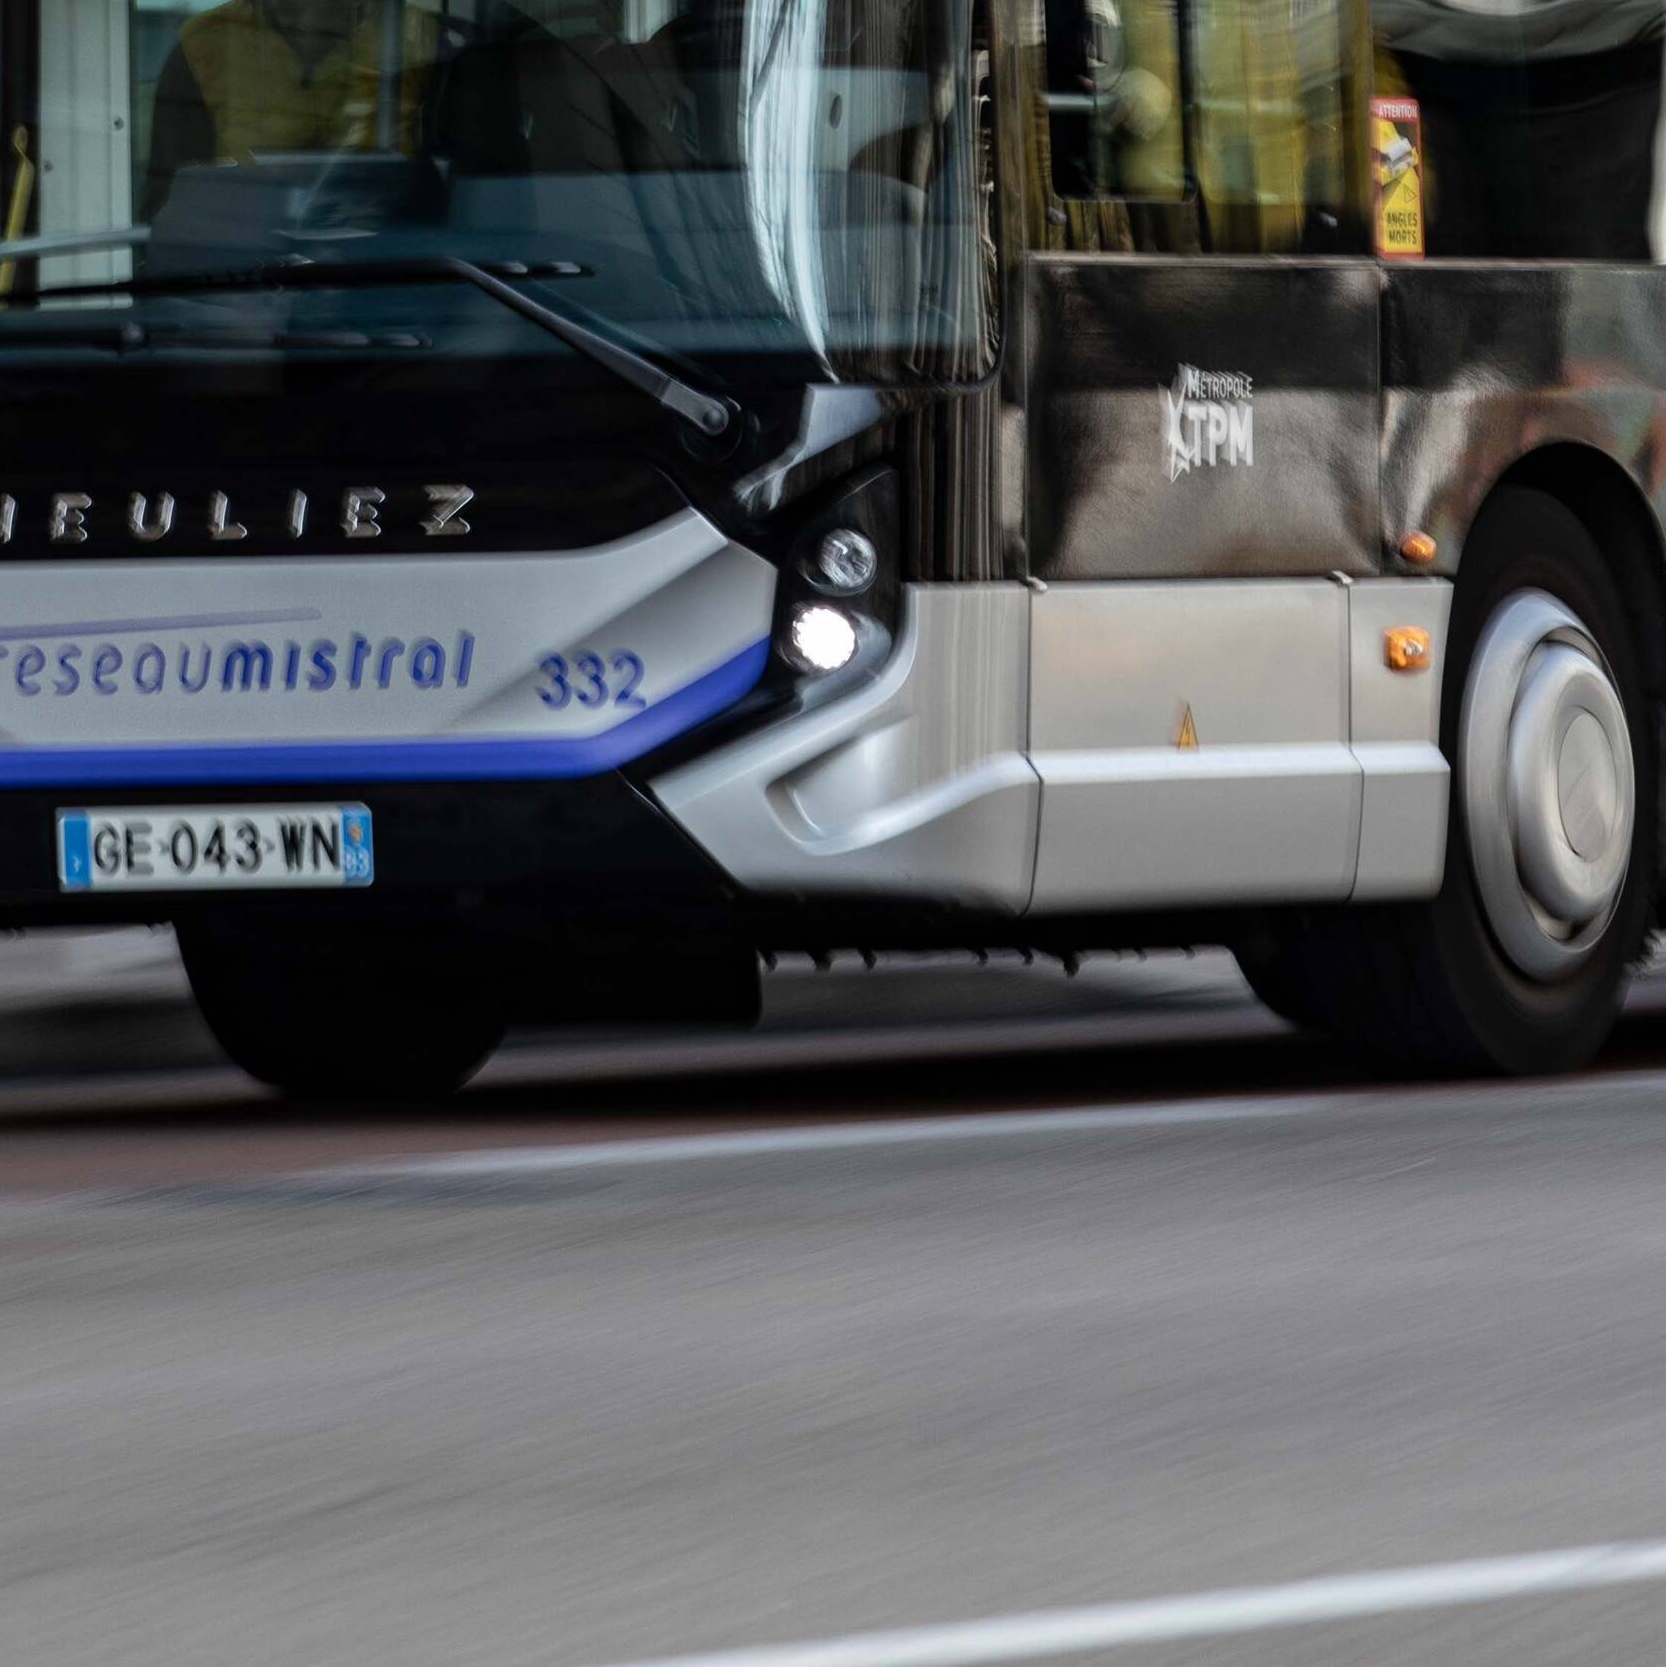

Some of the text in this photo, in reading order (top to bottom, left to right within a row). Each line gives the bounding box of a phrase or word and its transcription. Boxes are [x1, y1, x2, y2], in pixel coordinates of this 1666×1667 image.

[1378, 103, 1419, 119] ATTENTION
[1387, 211, 1418, 227] ANGLES
[1389, 231, 1417, 246] MORTS
[1186, 403, 1254, 467] TPM
[535, 648, 648, 710] 332
